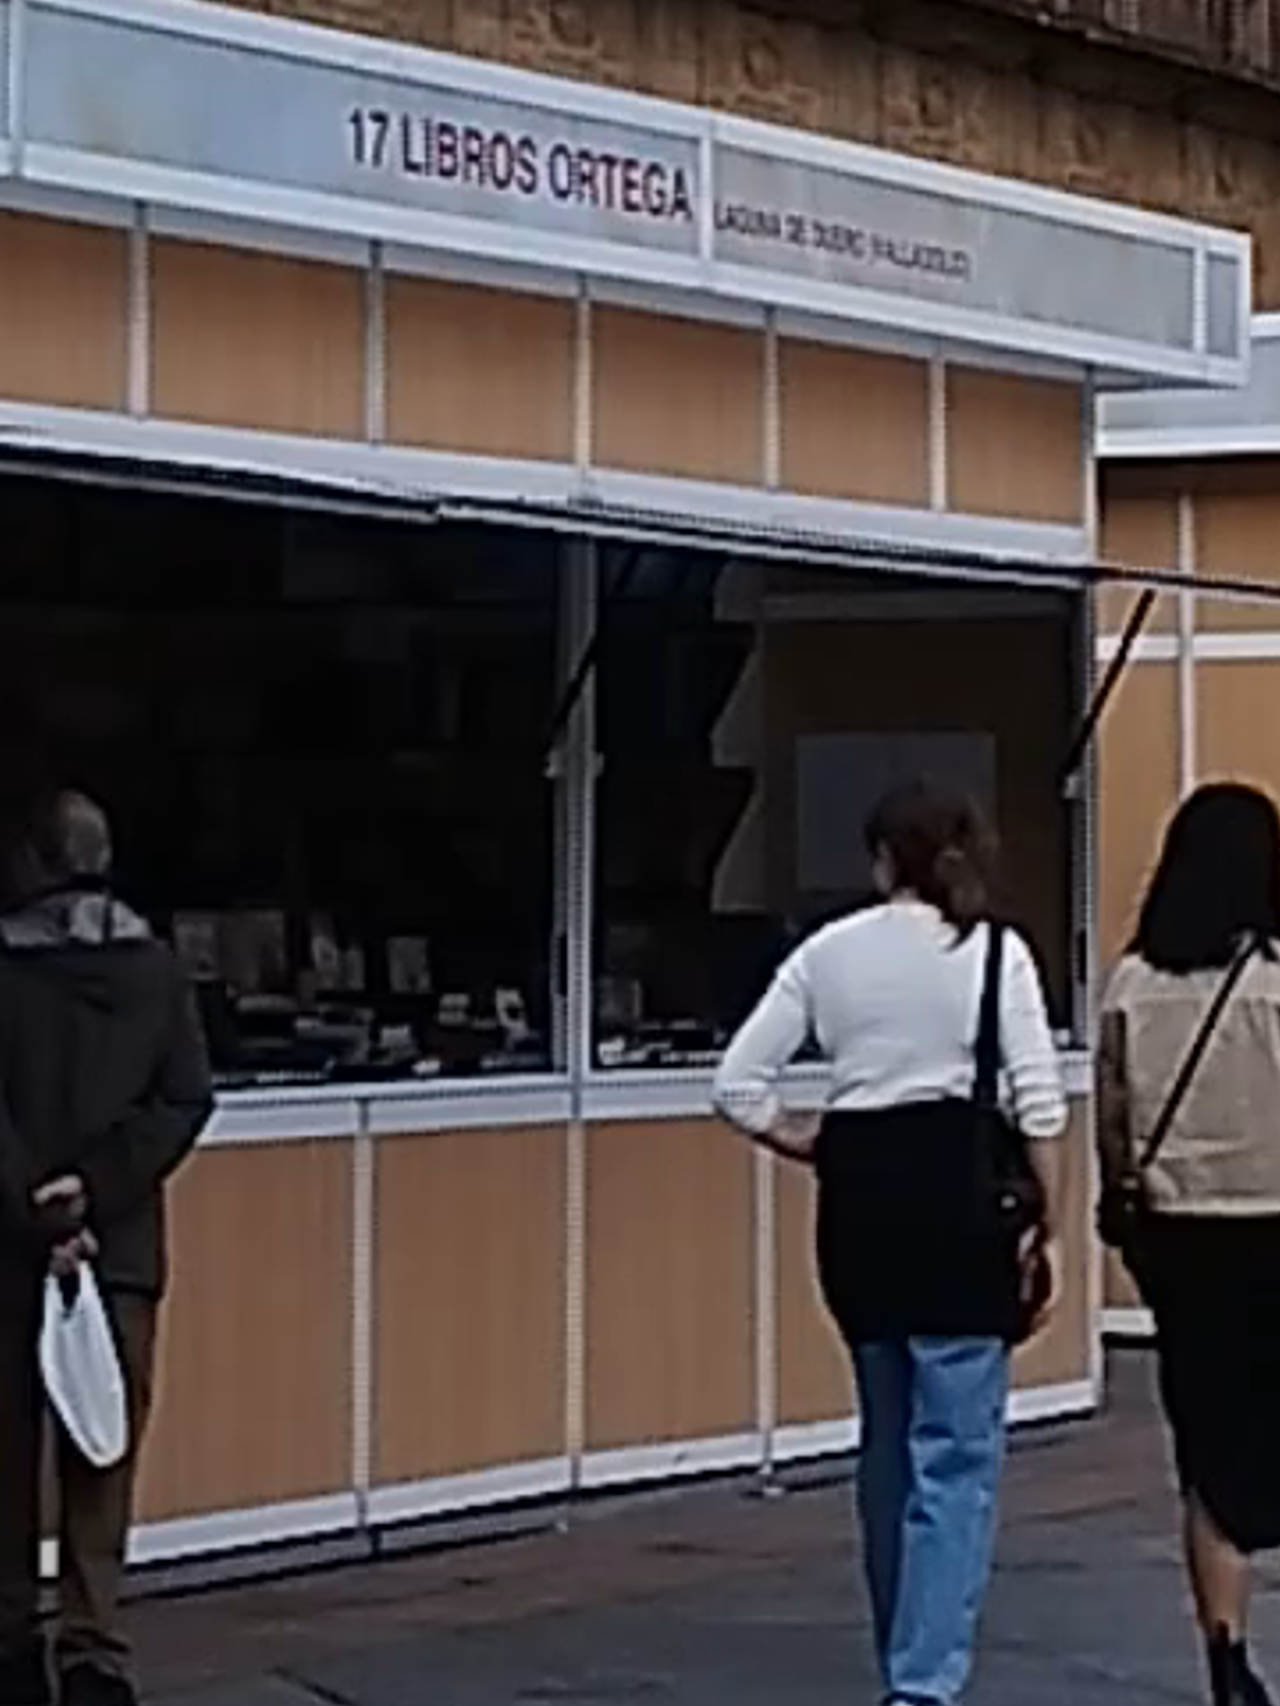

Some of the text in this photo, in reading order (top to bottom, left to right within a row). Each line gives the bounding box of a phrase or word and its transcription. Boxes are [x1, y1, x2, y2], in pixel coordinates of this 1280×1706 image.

[349, 107, 694, 222] 17 LIBROS ORTEGA
